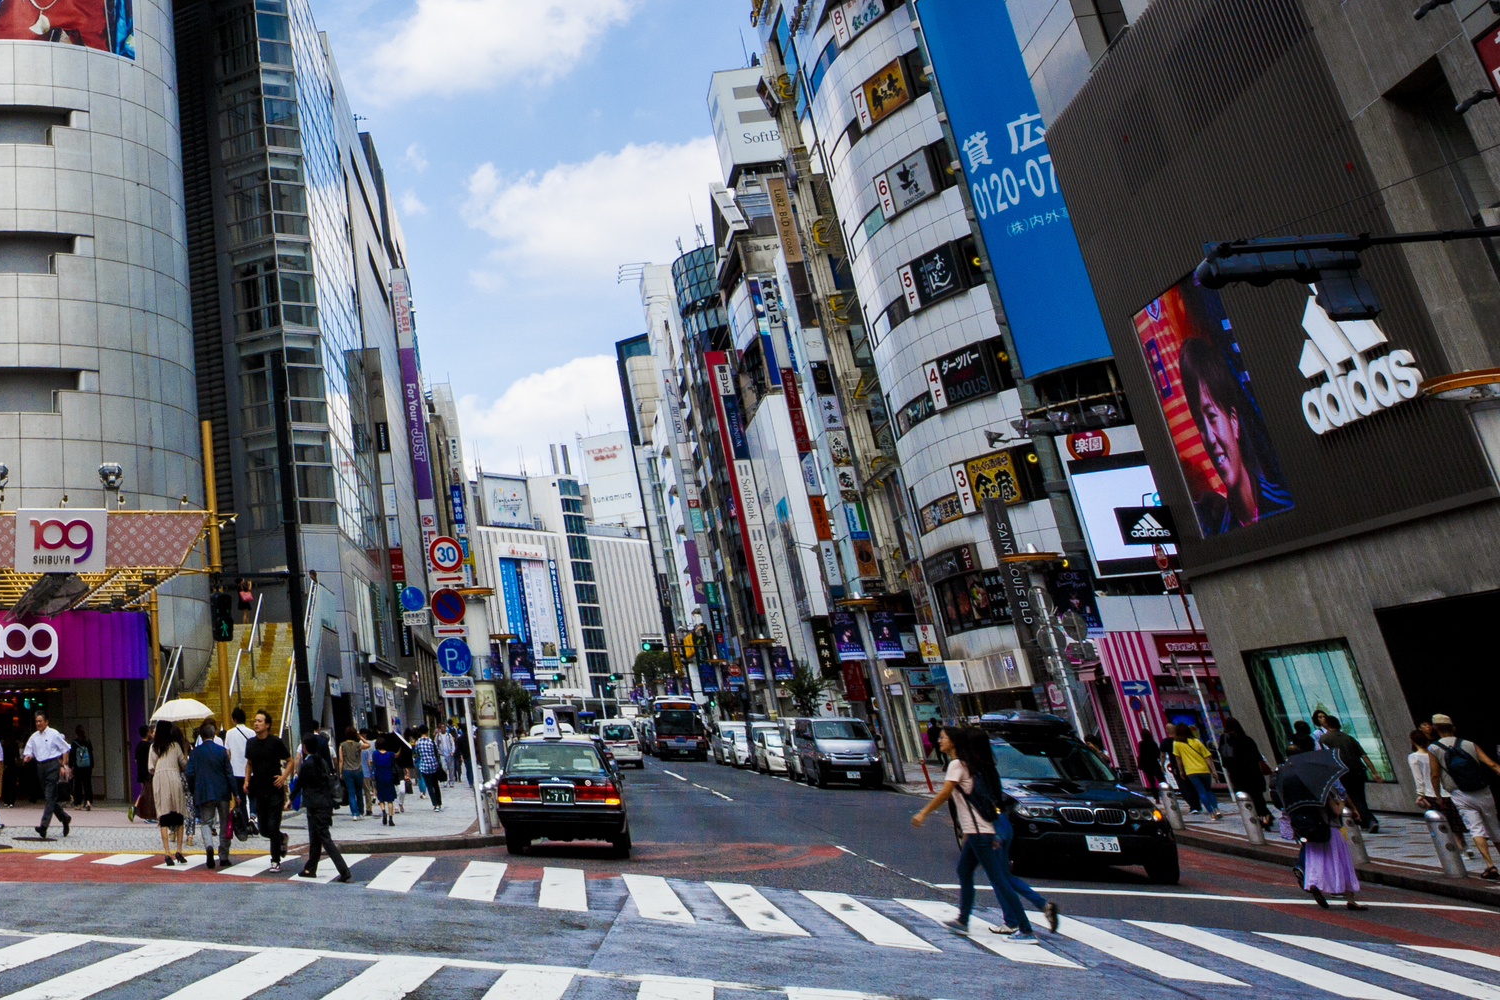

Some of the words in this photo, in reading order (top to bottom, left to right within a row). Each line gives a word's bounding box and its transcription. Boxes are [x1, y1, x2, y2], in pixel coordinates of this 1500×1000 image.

[962, 131, 993, 174] 貸
[941, 350, 979, 376] ダーツバー
[406, 382, 417, 400] For
[948, 375, 989, 401] BAGUS
[1301, 348, 1424, 436] adidas
[407, 400, 419, 422] Your
[1074, 435, 1103, 454] 楽園
[592, 492, 632, 504] Bunkamura
[740, 478, 756, 520] SoftBank
[29, 518, 94, 565] 109
[1130, 527, 1171, 538] adidas
[32, 555, 71, 565] SHIBUYA
[436, 546, 457, 563] 30
[754, 543, 771, 587] SoftBank
[1018, 600, 1034, 625] BLD
[768, 611, 784, 647] SoftBa
[444, 648, 459, 671] P
[456, 660, 466, 671] 40
